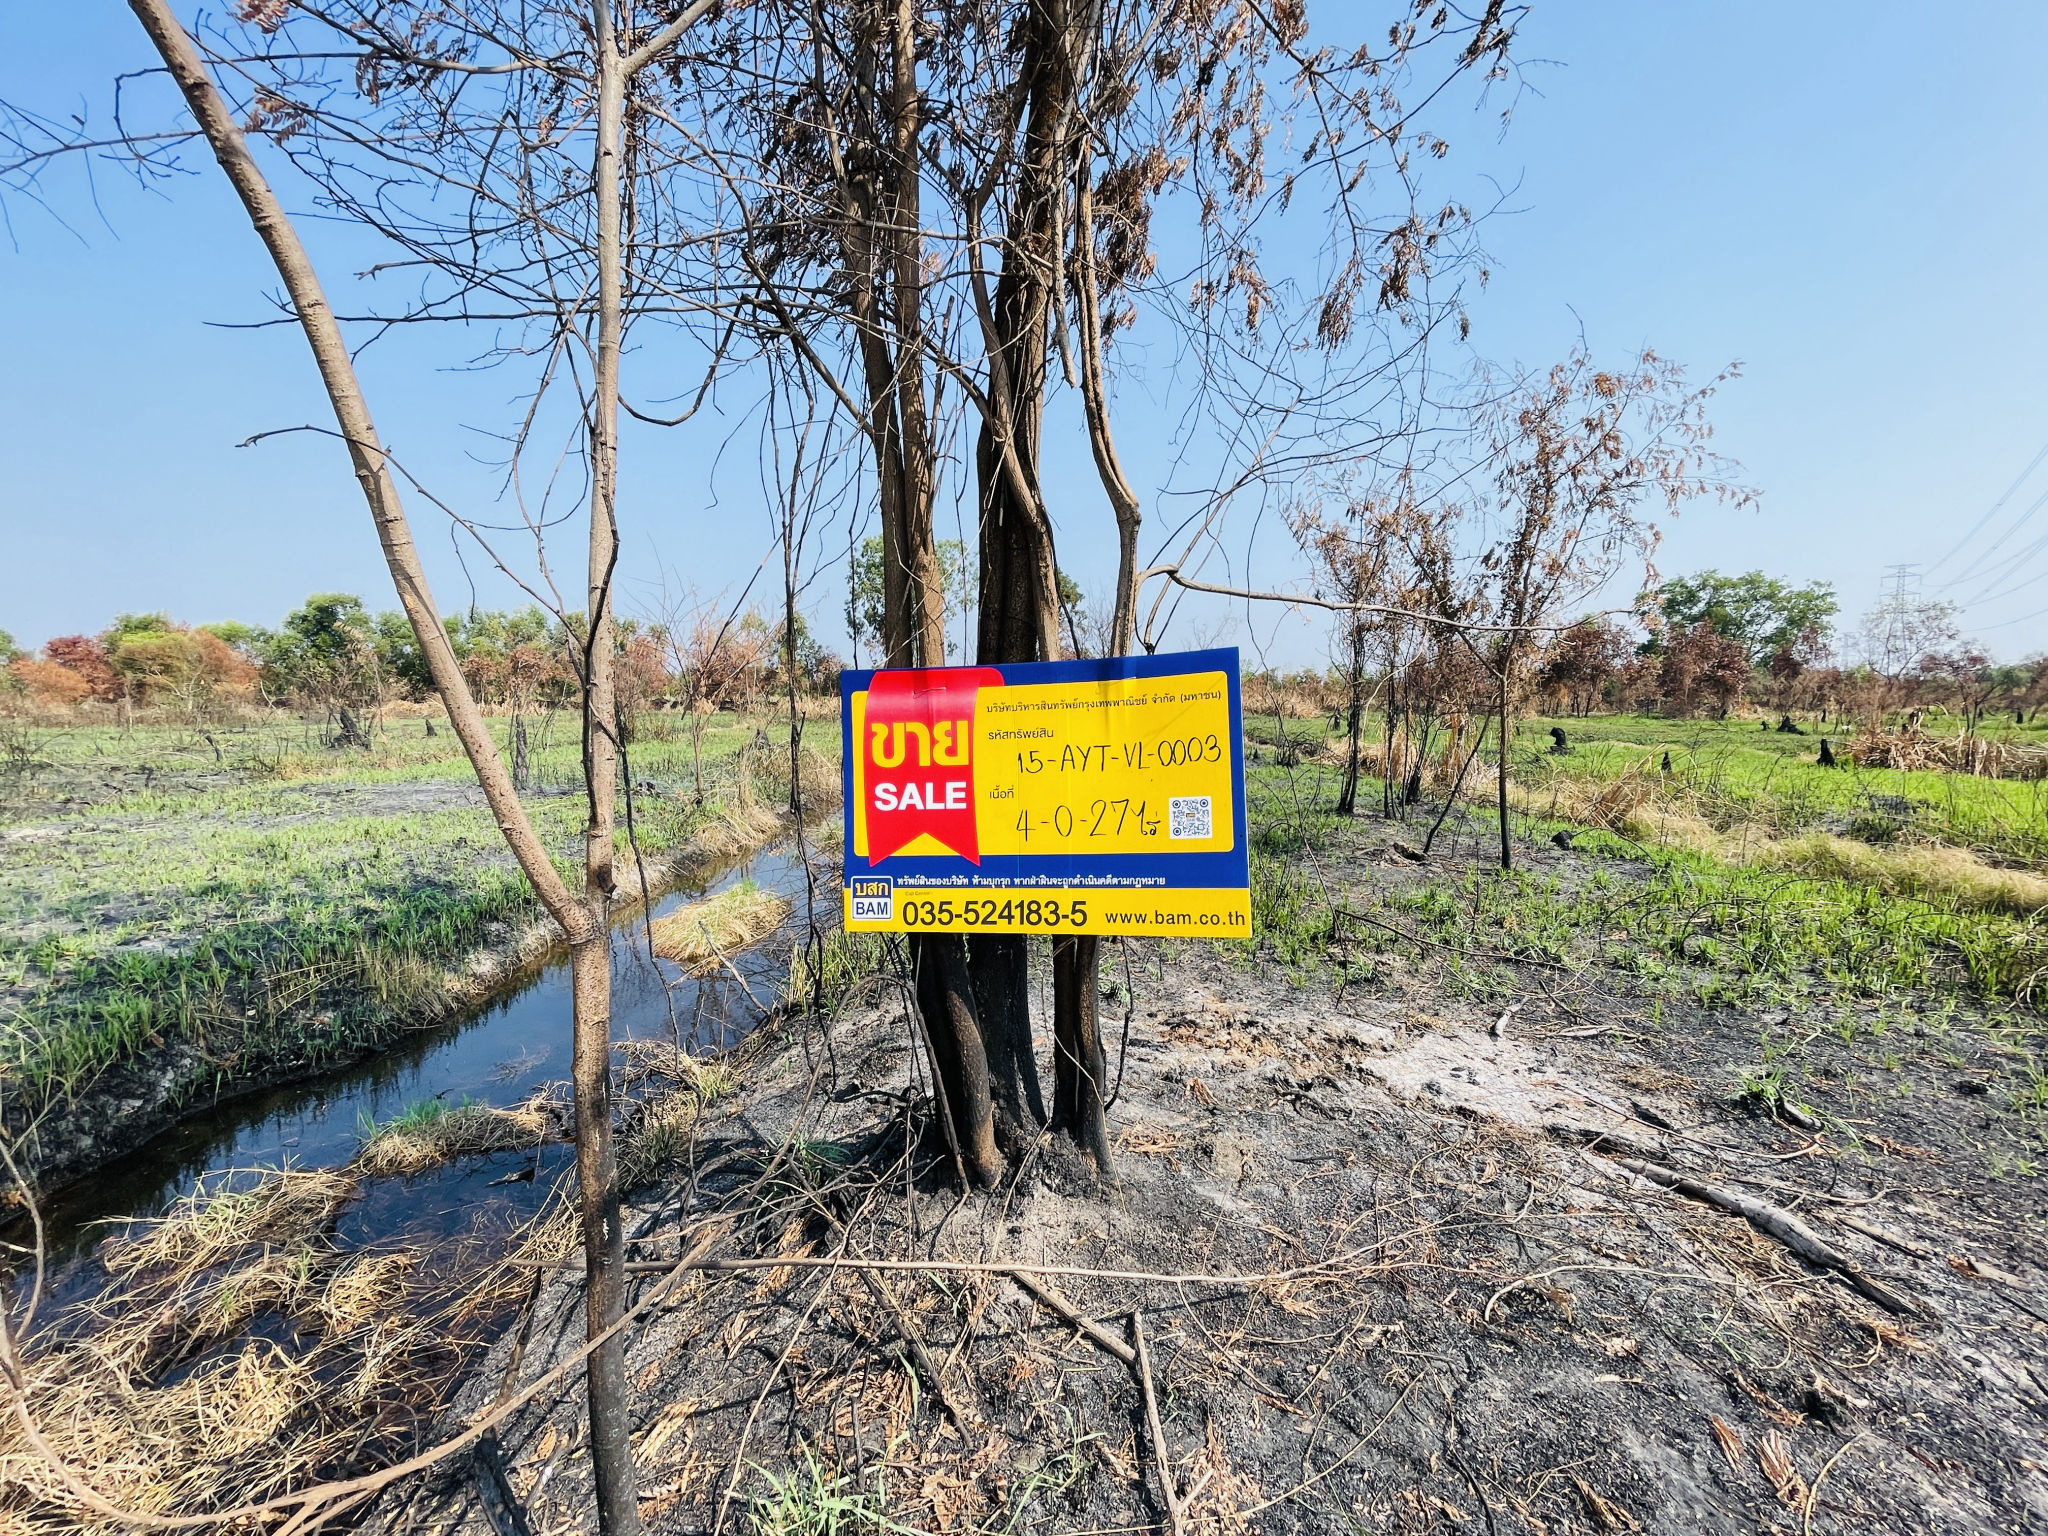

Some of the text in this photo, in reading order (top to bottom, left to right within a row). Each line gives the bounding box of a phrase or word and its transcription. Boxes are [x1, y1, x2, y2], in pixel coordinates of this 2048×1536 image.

[986, 689, 1222, 713] บริษัทบริหารสินทรัพย์กรุงเทพพาณิชย์ จำกัด (มหาชน)
[988, 727, 1054, 741] รหัสทรัพย์สิน
[871, 720, 969, 768] ขาย
[874, 781, 967, 811] SALE
[989, 784, 1015, 799] เนื้อที่
[855, 881, 889, 896] บสก
[897, 874, 969, 886] ทรัพย์สินของบริษัท
[972, 875, 1011, 888] ห้ามบุกรุก
[855, 901, 889, 915] BAM
[902, 900, 1088, 926] 035-524183-5
[1105, 910, 1246, 926] www.bam.co.th
